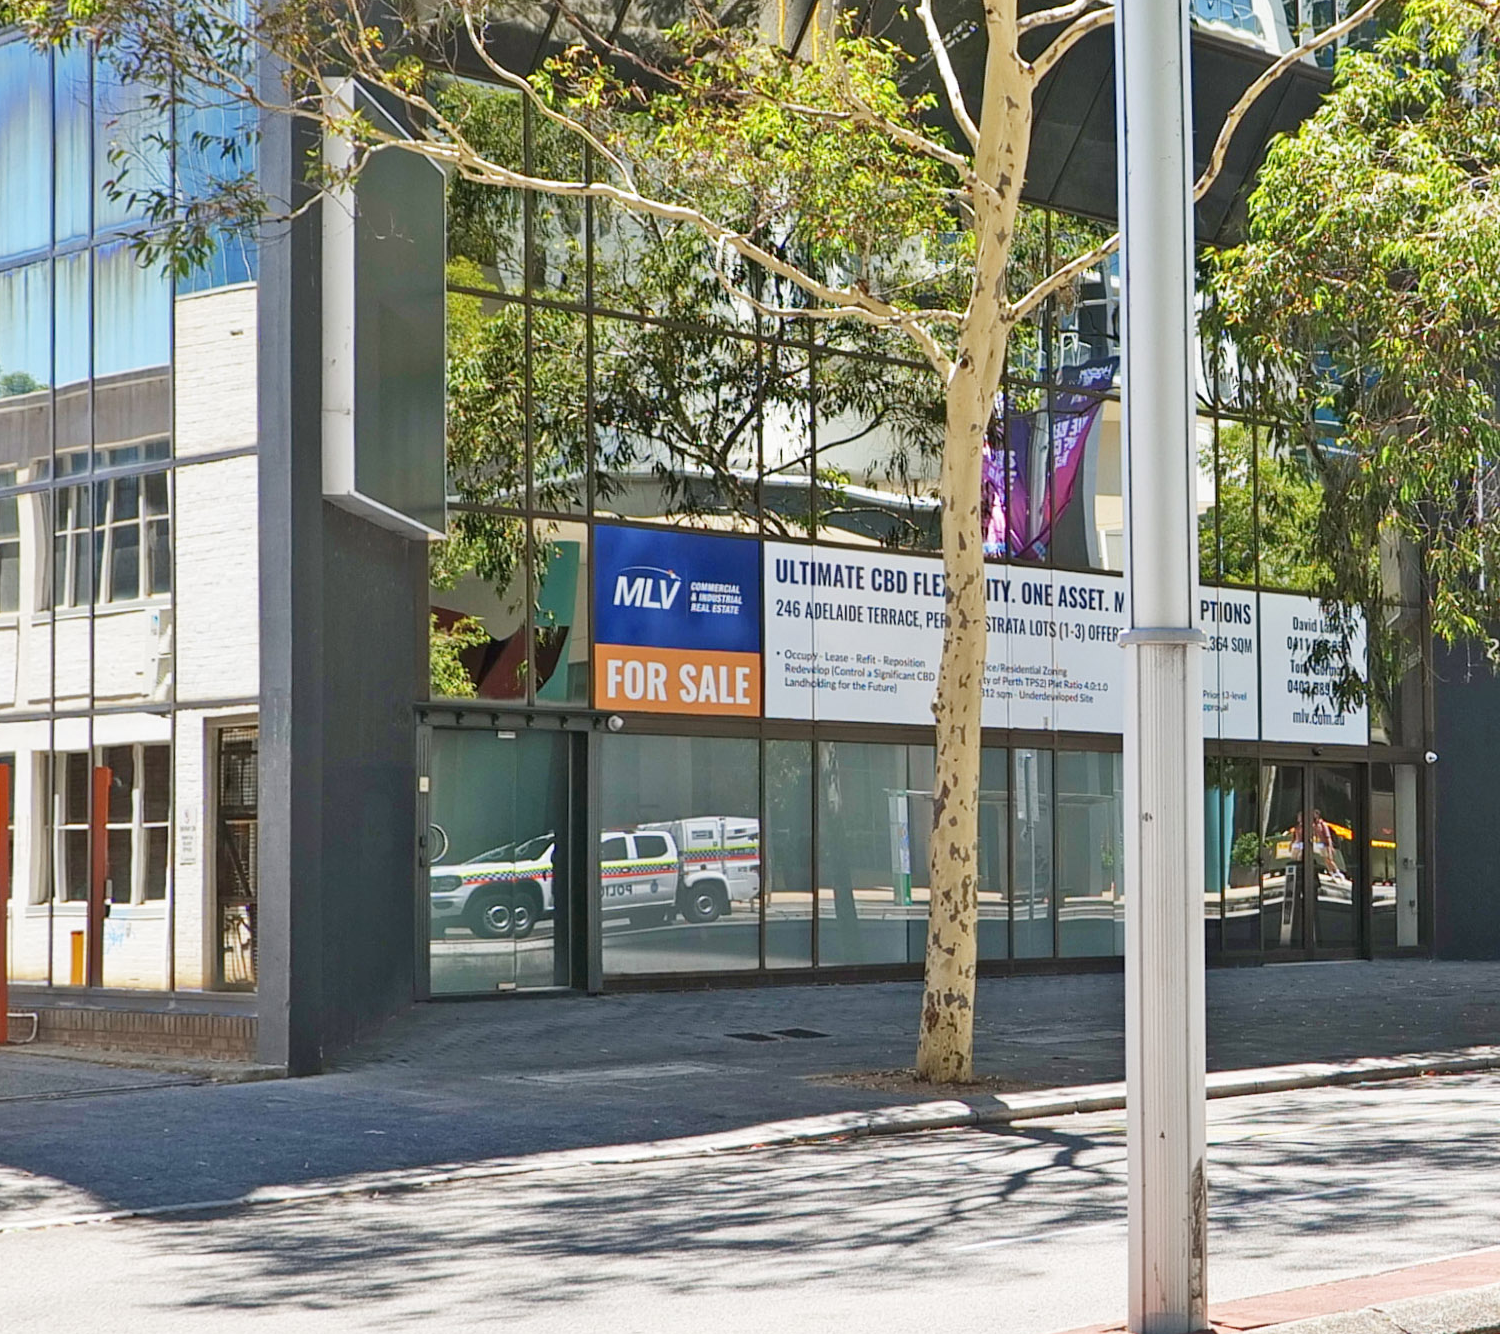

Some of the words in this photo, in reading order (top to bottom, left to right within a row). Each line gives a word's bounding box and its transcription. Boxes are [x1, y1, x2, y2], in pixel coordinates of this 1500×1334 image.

[613, 575, 682, 610] MLV
[690, 582, 741, 595] COMMERCIAL
[775, 558, 865, 590] ULTIMATE
[871, 567, 908, 594] CBD
[1021, 581, 1054, 607] ONE
[1058, 585, 1109, 612] ASSET.
[699, 593, 743, 605] INDUSTRIAL
[690, 603, 710, 613] REAL
[712, 604, 740, 615] ESTATE
[776, 599, 801, 618] 246
[805, 601, 864, 624] ADELAIDE
[867, 606, 923, 630] TERRACE,
[1200, 599, 1252, 625] PTIONS
[986, 615, 1026, 636] STRATA
[1030, 620, 1057, 638] LOTS
[1059, 621, 1086, 643] (1-3)
[1293, 617, 1317, 633] David
[1231, 638, 1253, 655] SQM
[784, 649, 819, 662] Occupy
[825, 651, 849, 663] Lease
[856, 653, 876, 665] Refit
[883, 655, 926, 668] Reposition
[784, 663, 830, 677] Redevelop
[831, 665, 865, 678] (Control
[874, 668, 916, 681] Significant
[916, 671, 936, 682] CBD
[1042, 666, 1068, 678] Zoning
[607, 659, 668, 702] FOR
[678, 663, 750, 705] SALE
[784, 677, 837, 691] Landholding
[838, 680, 850, 690] for
[852, 680, 867, 691] the
[867, 681, 897, 694] Future)
[993, 676, 1001, 686] of
[1002, 676, 1024, 687] Perth
[1064, 680, 1083, 690] Ratio
[1019, 691, 1079, 703] Underdeveloped
[1079, 693, 1094, 704] Site
[1293, 708, 1345, 726] mlv.com.au
